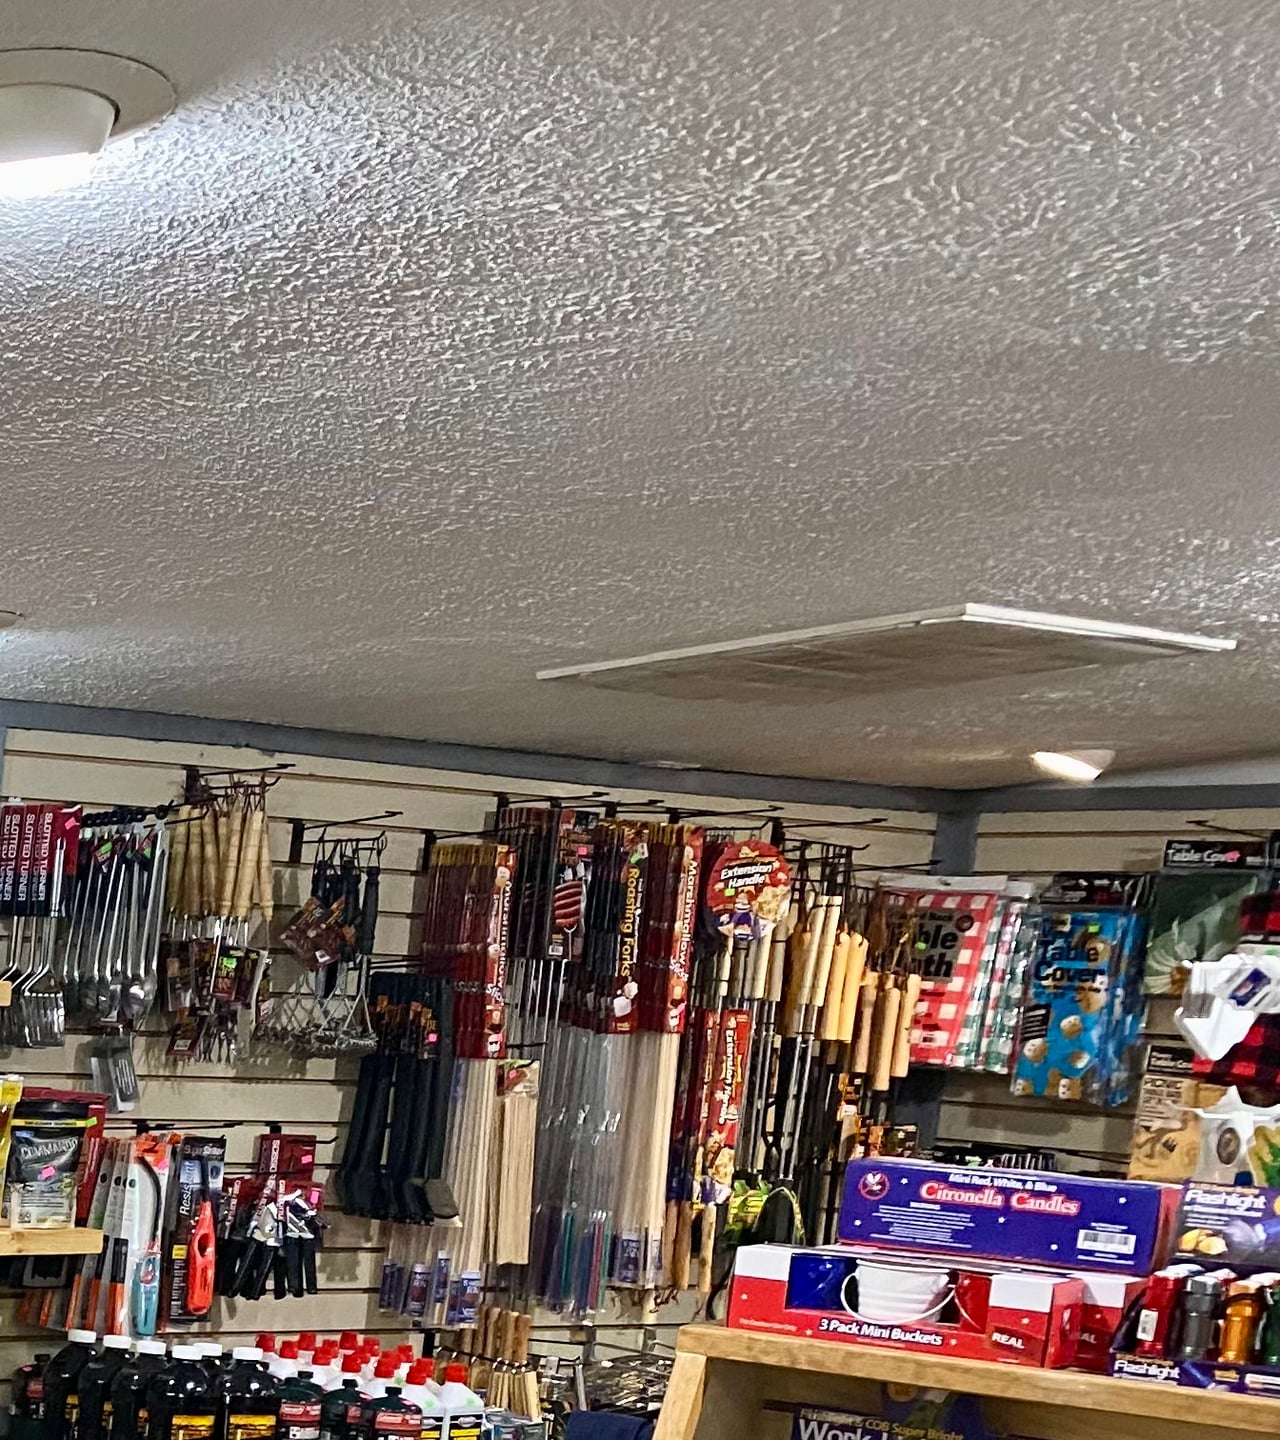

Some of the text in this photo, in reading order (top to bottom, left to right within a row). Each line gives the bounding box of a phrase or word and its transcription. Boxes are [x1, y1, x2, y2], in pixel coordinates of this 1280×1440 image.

[720, 863, 774, 880] Extension
[728, 873, 766, 889] Handle
[620, 867, 641, 978] Roasting Forks
[949, 1174, 968, 1184] Mini
[1034, 1181, 1058, 1192] Blue
[920, 1181, 1079, 1215] Citronella Candles
[1185, 1189, 1266, 1211] Flashlight
[819, 1319, 943, 1347] 3 Pack Mini Buckets
[991, 1332, 1025, 1349] REAL
[1114, 1359, 1180, 1380] Flashlight
